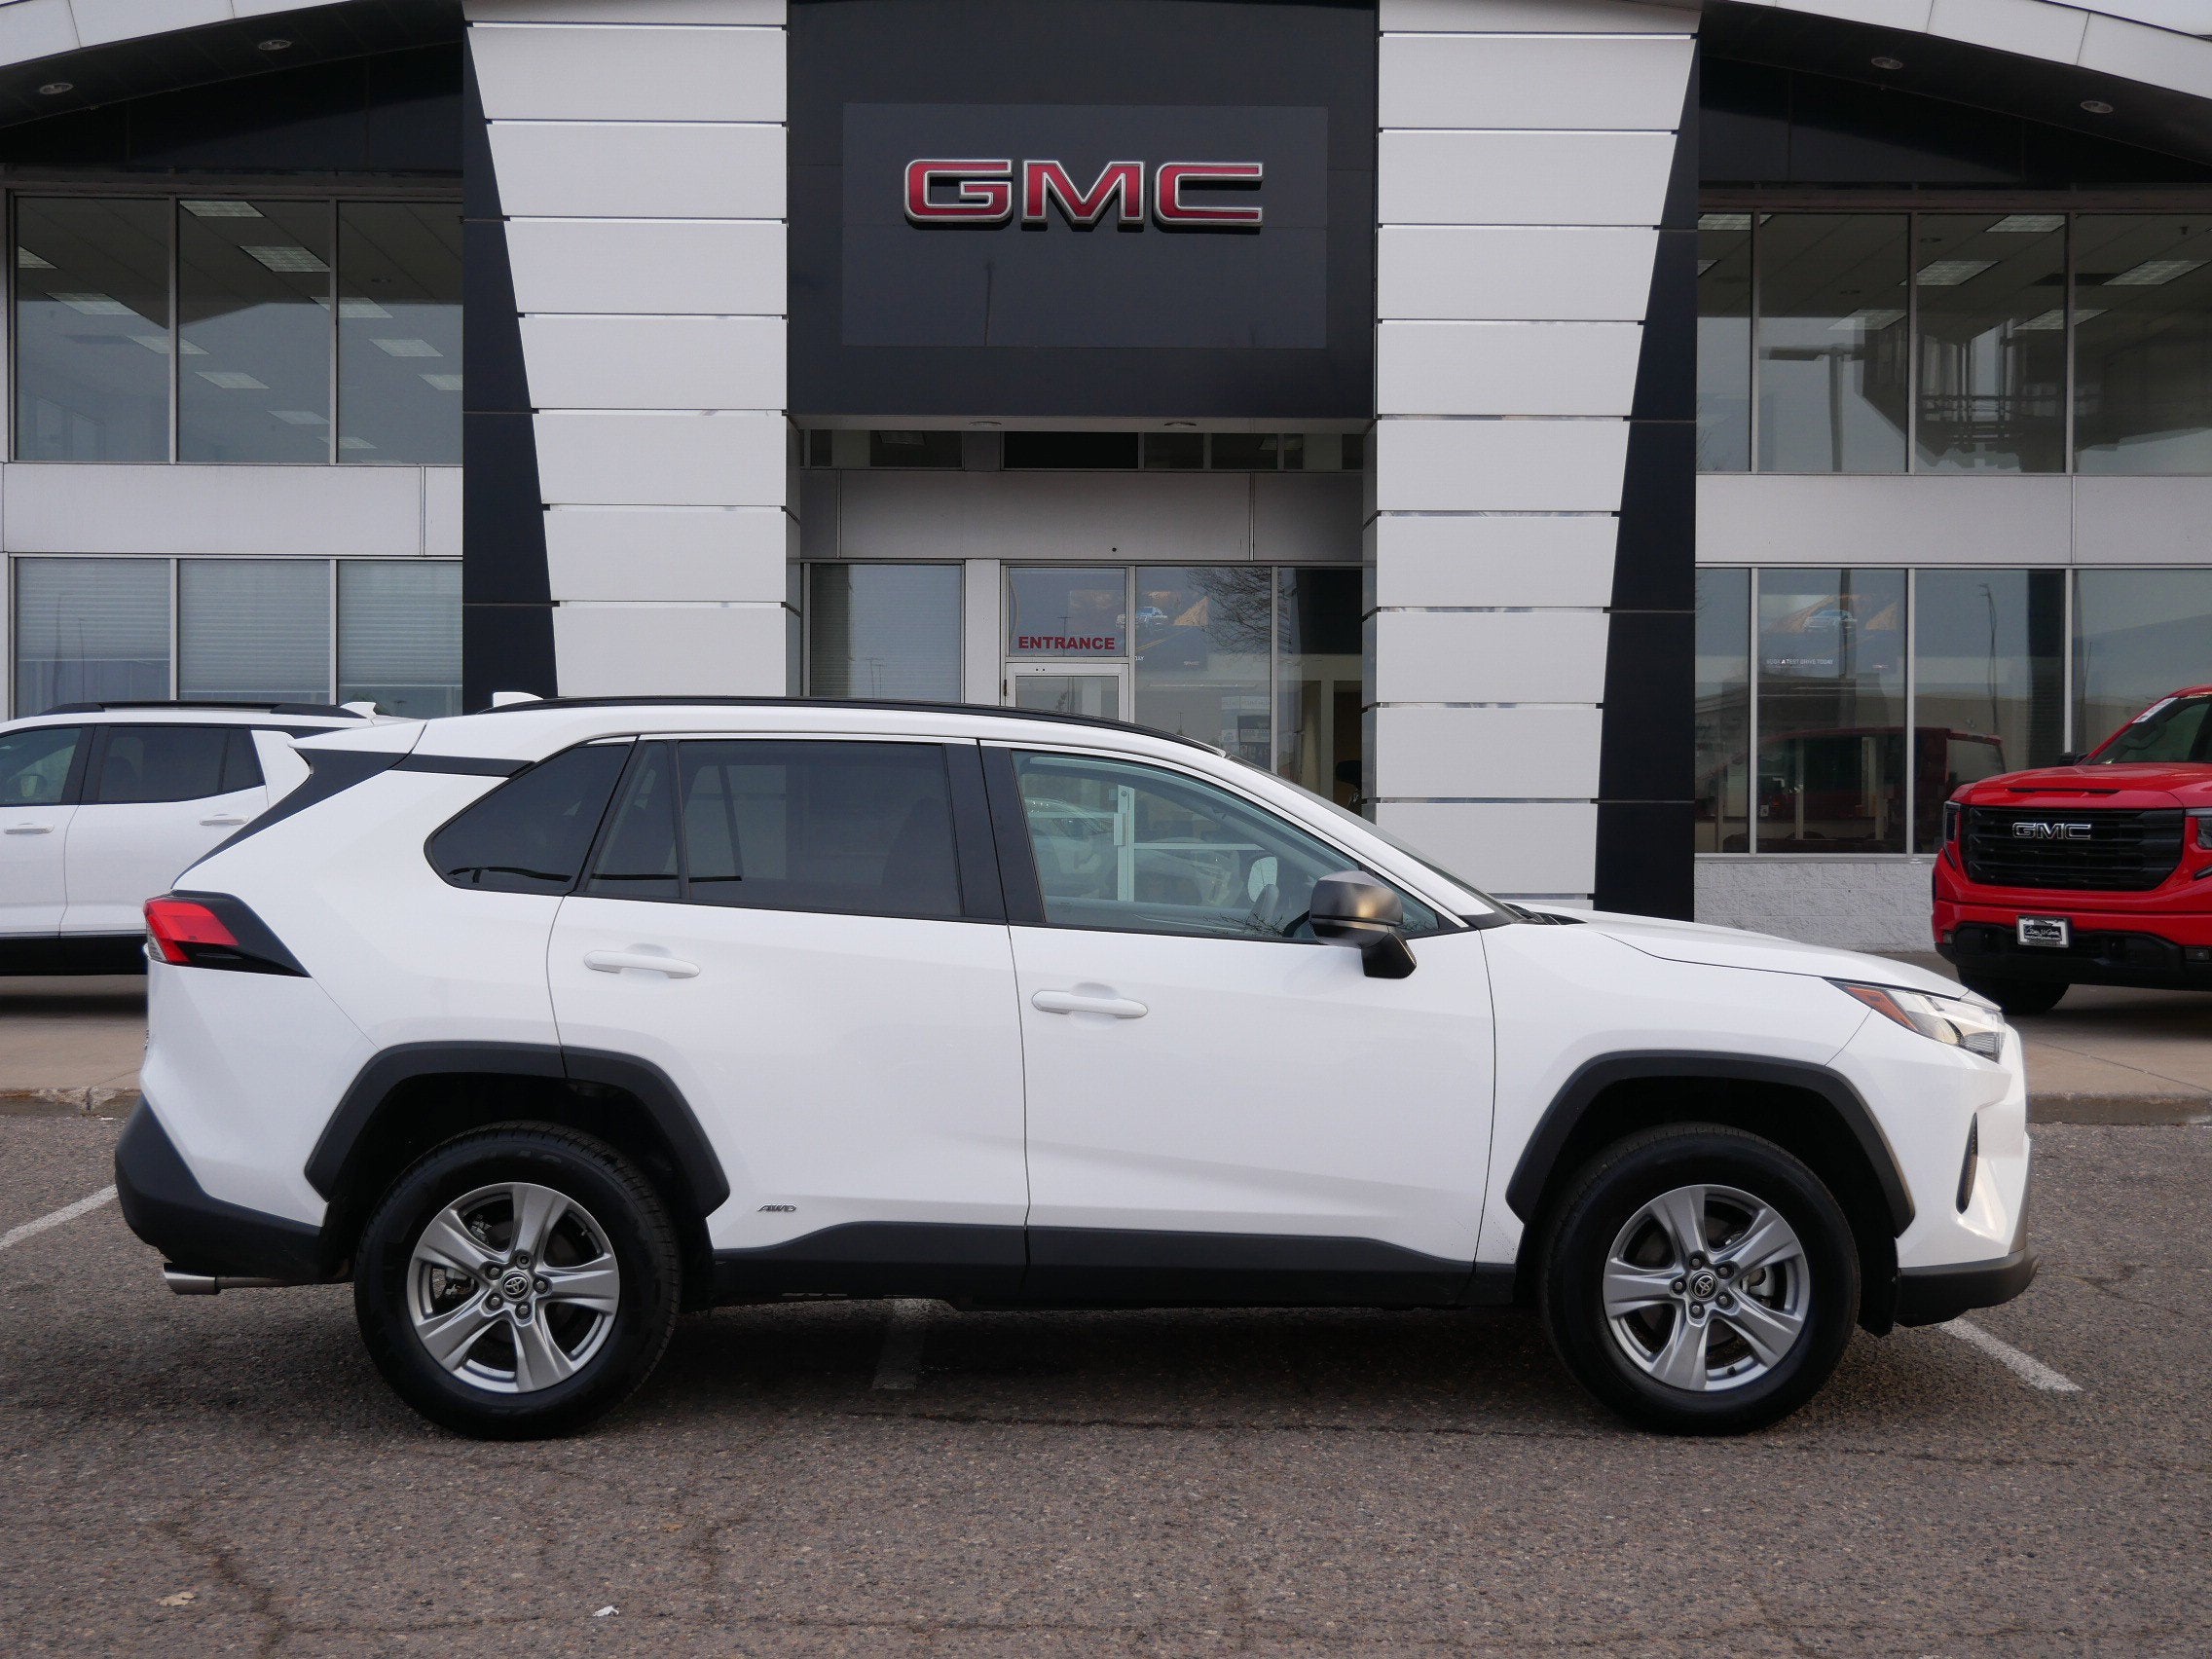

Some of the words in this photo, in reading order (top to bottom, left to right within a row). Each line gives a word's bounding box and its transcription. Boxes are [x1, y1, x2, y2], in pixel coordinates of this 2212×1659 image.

[903, 159, 1264, 233] GMC
[1018, 636, 1115, 650] ENTRANCE
[2011, 822, 2091, 840] GMC
